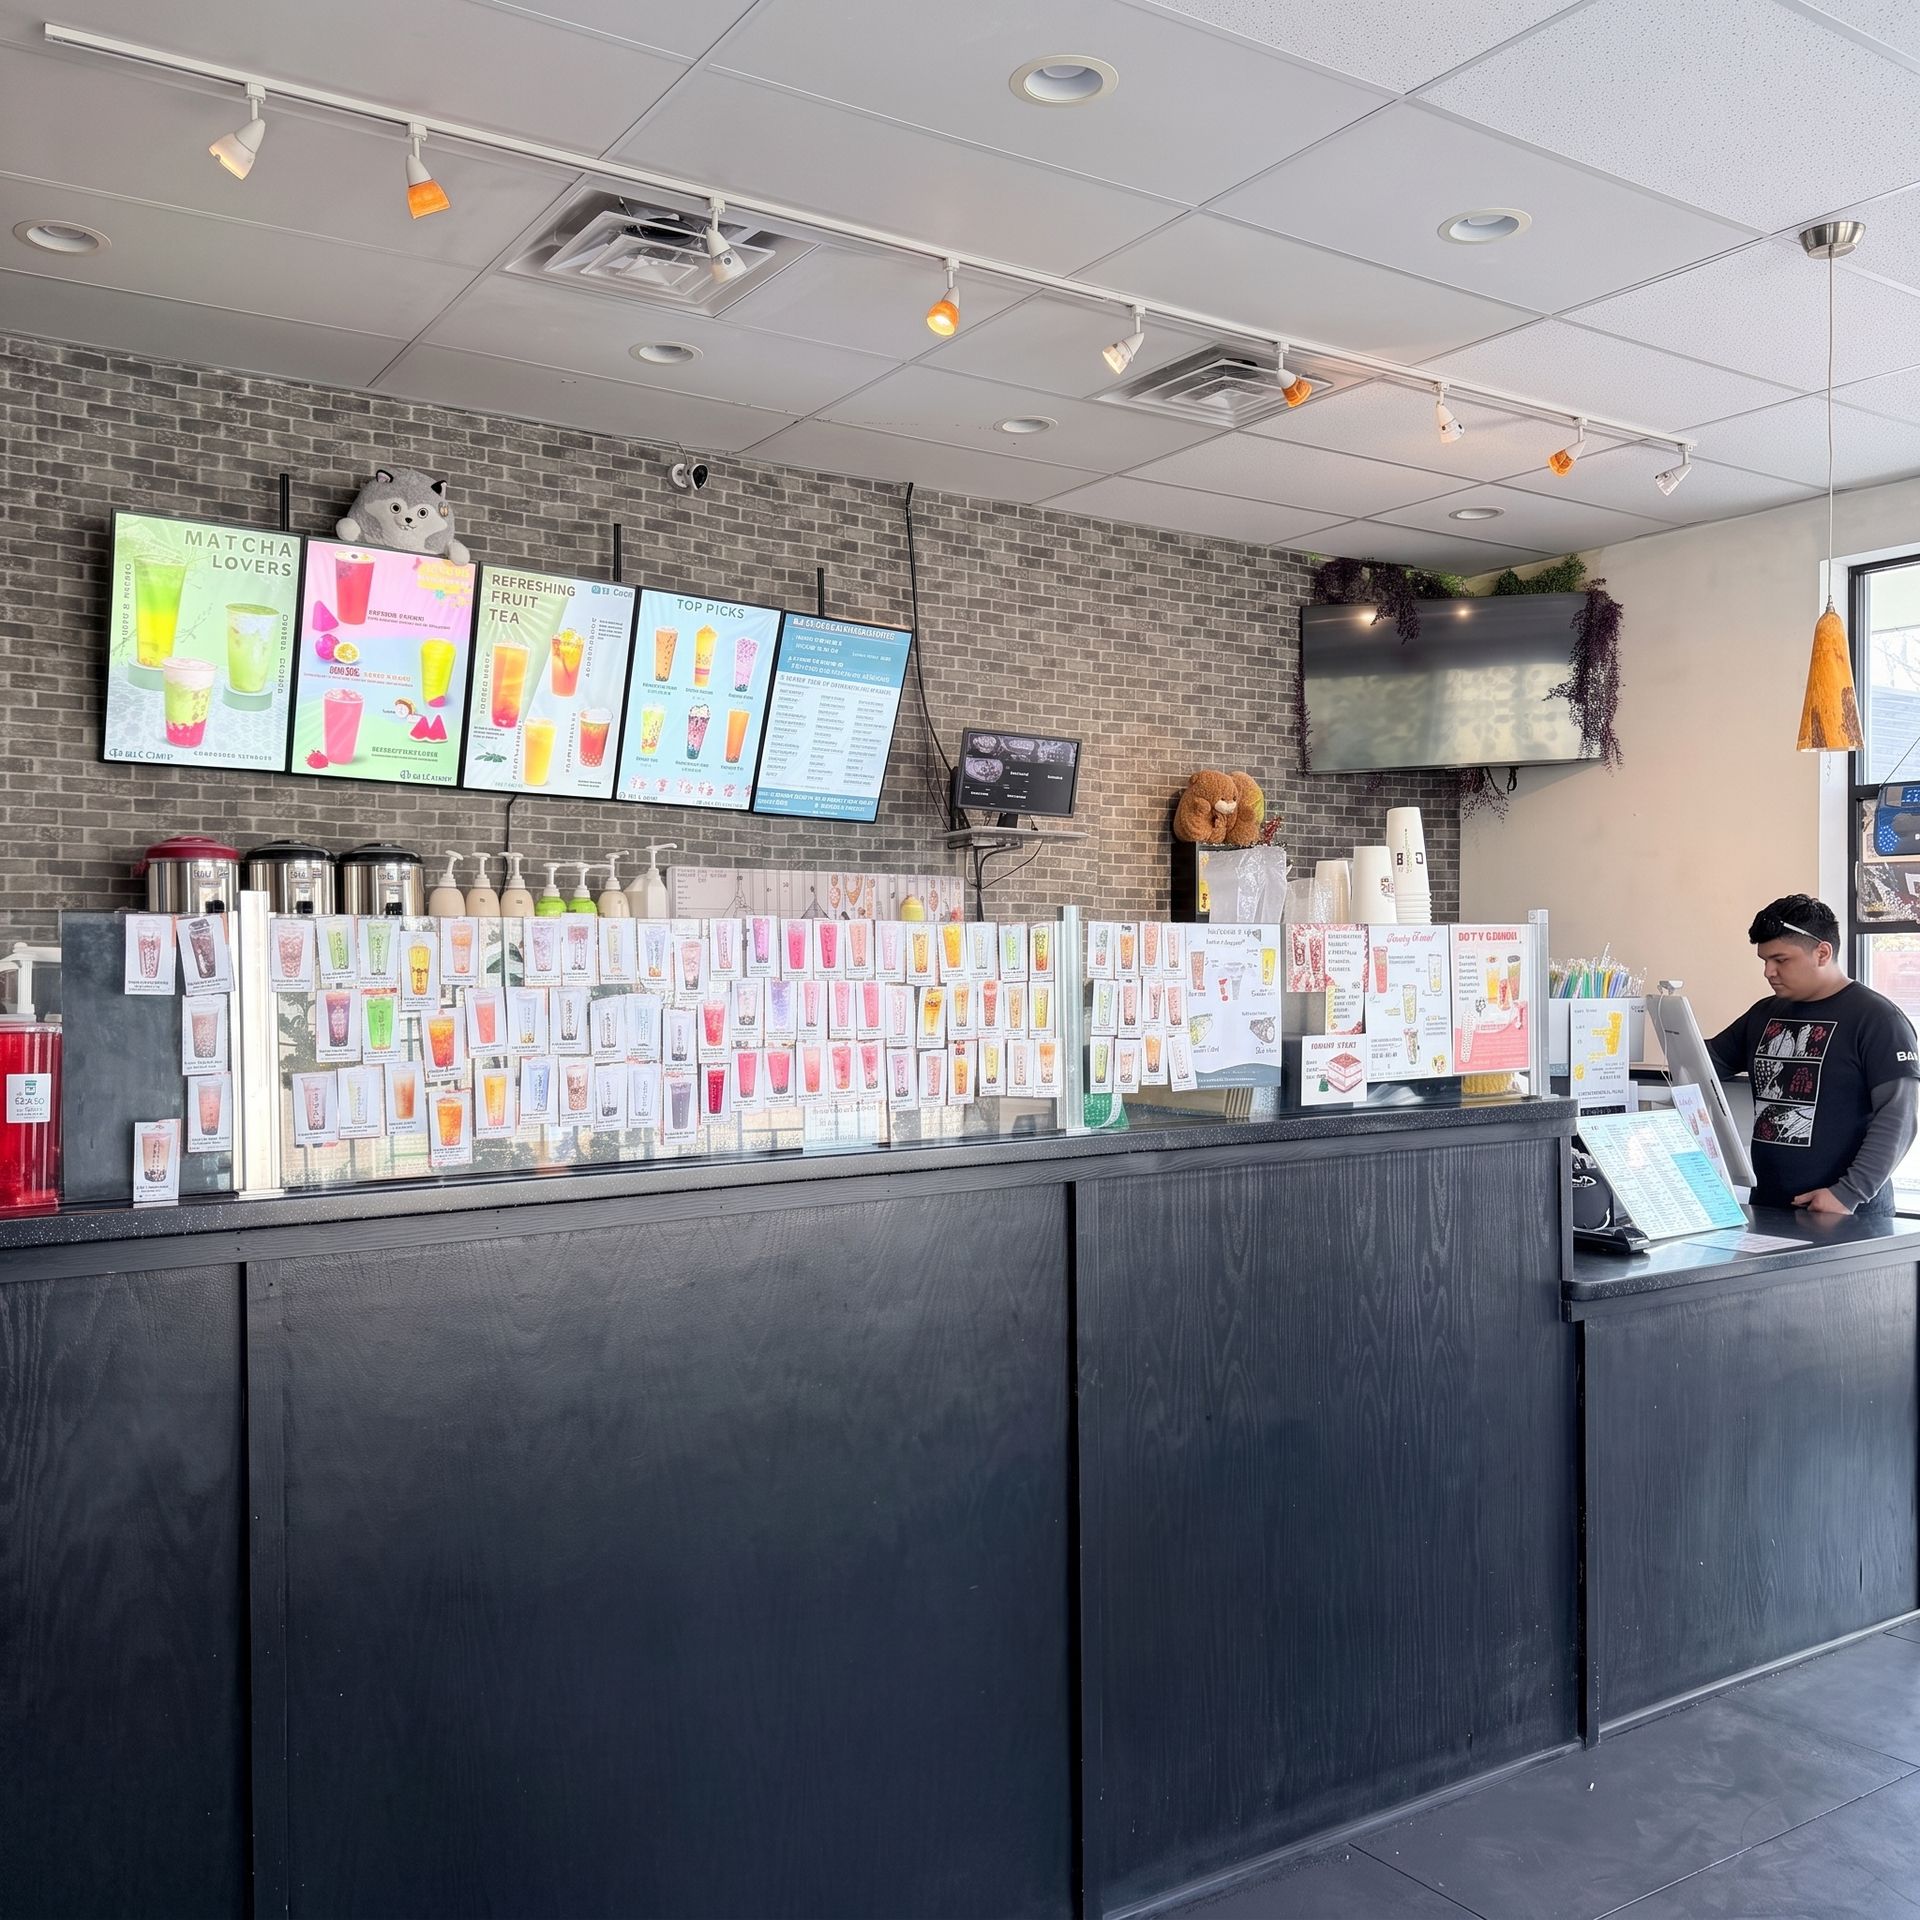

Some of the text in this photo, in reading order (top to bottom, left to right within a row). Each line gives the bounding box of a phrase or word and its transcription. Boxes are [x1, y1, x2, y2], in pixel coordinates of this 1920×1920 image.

[185, 530, 292, 558] MATCHA
[212, 555, 292, 577] LOVERS
[492, 574, 576, 597] REFRESHING
[491, 590, 538, 609] FRUIT
[677, 599, 745, 619] TOP PICKS
[489, 608, 520, 625] TEA
